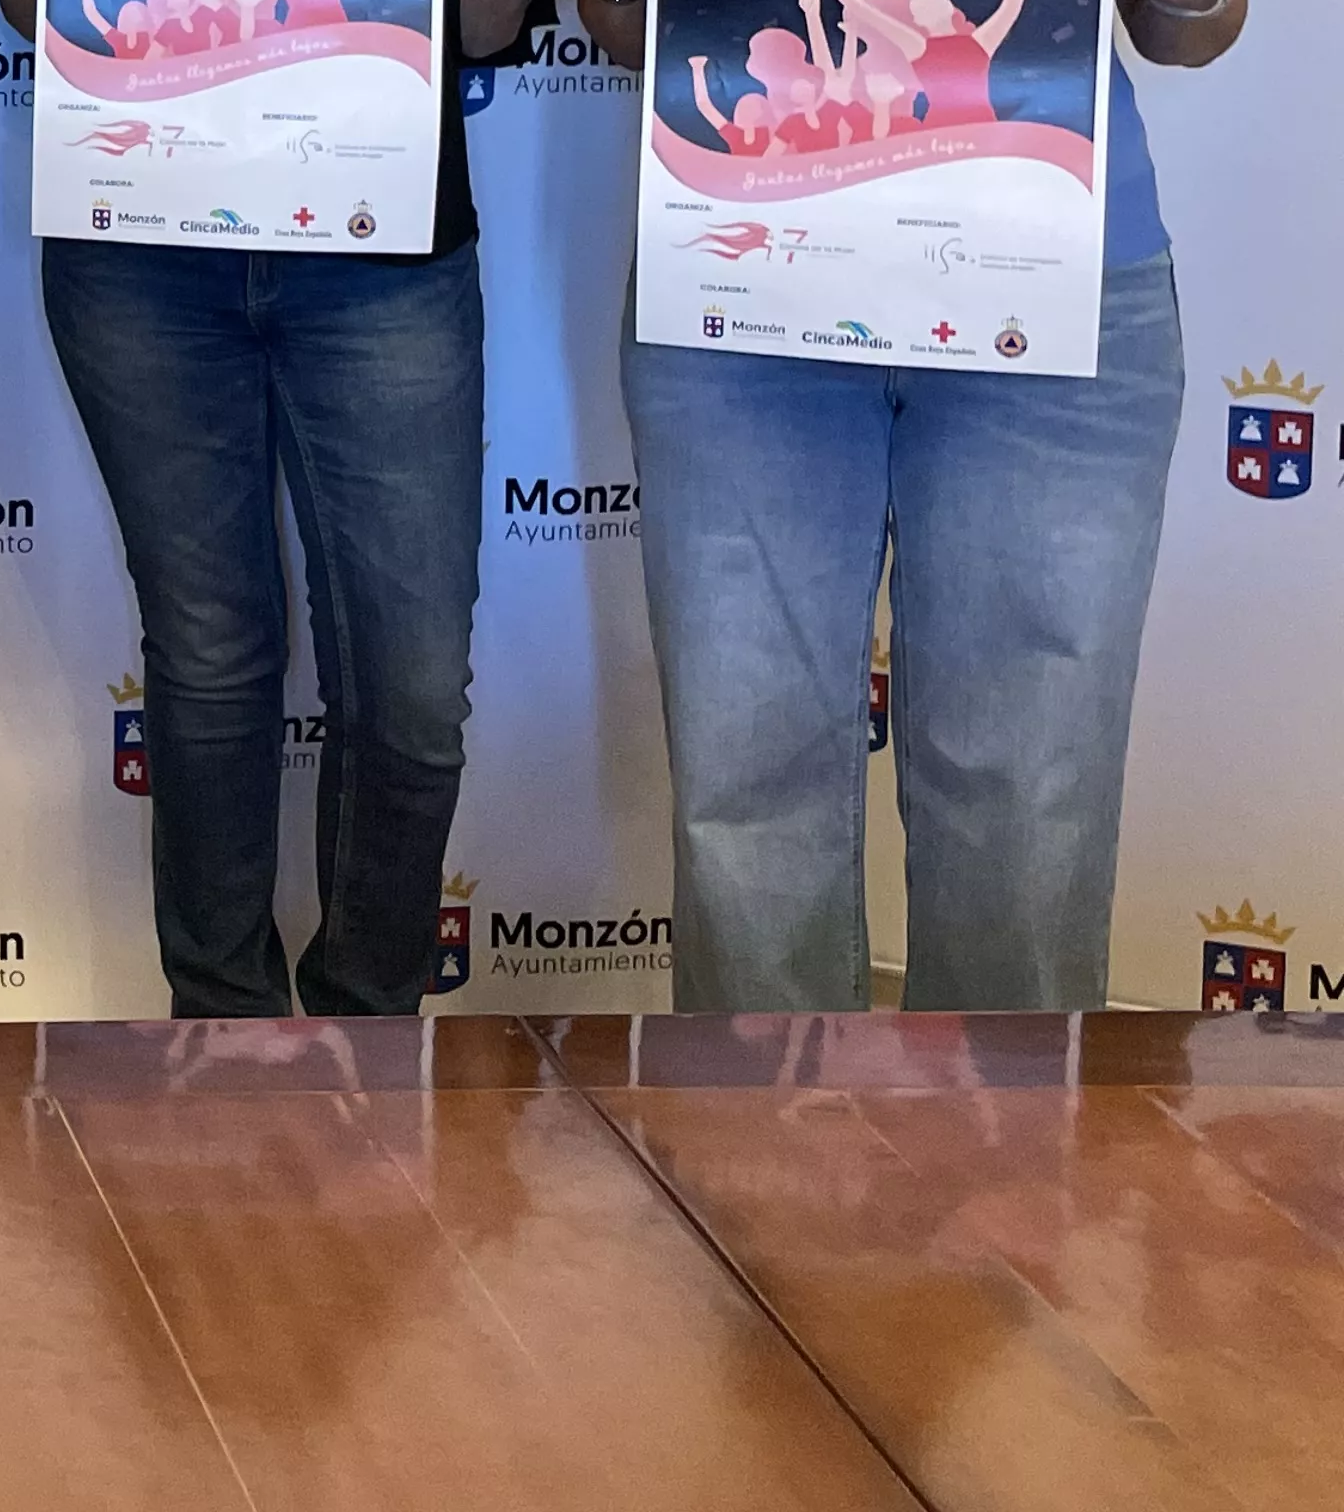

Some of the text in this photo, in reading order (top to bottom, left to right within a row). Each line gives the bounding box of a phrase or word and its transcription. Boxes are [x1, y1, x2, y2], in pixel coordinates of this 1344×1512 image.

[514, 73, 640, 96] Ayuntami
[118, 212, 166, 225] Monzón
[179, 219, 260, 236] CincaMedio
[732, 319, 786, 336] Monzón
[802, 331, 893, 351] CincaMedio
[505, 478, 640, 515] Monz
[505, 519, 640, 545] Ayuntamie
[492, 910, 672, 948] Monzón
[492, 952, 672, 978] Ayuntamiento
